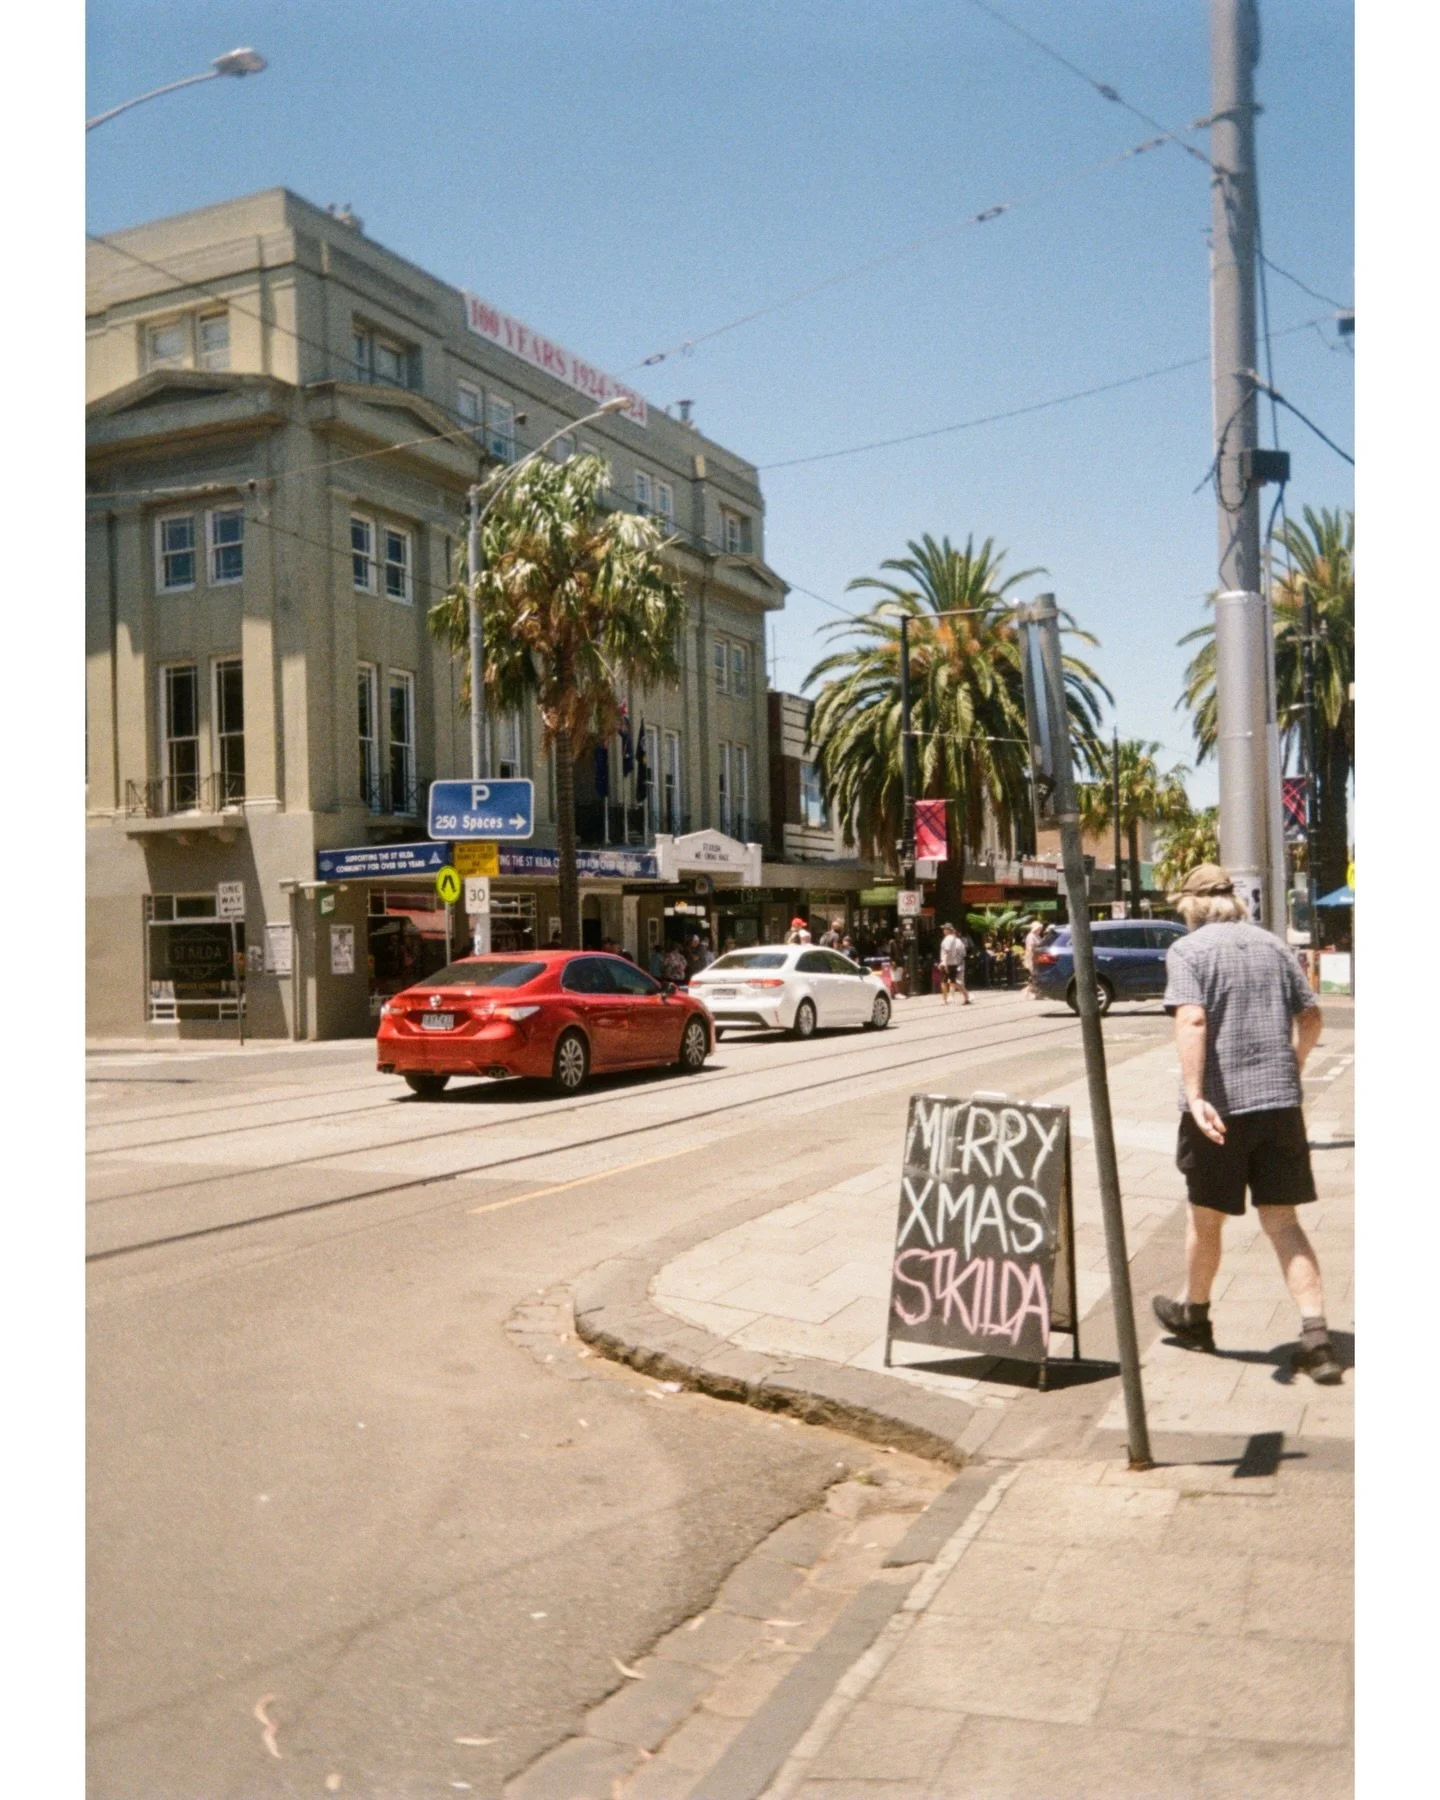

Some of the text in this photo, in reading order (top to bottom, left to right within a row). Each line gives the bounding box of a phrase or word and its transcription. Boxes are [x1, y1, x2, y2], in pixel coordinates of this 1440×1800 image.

[471, 299, 498, 338] 100
[504, 317, 565, 377] YEARS
[472, 784, 490, 810] P
[436, 815, 503, 832] 250 Spaces
[222, 884, 241, 893] ONE
[469, 889, 485, 901] 30
[222, 895, 241, 905] WAY
[904, 1098, 1061, 1180] MERRY
[897, 1176, 1047, 1261] XMAS
